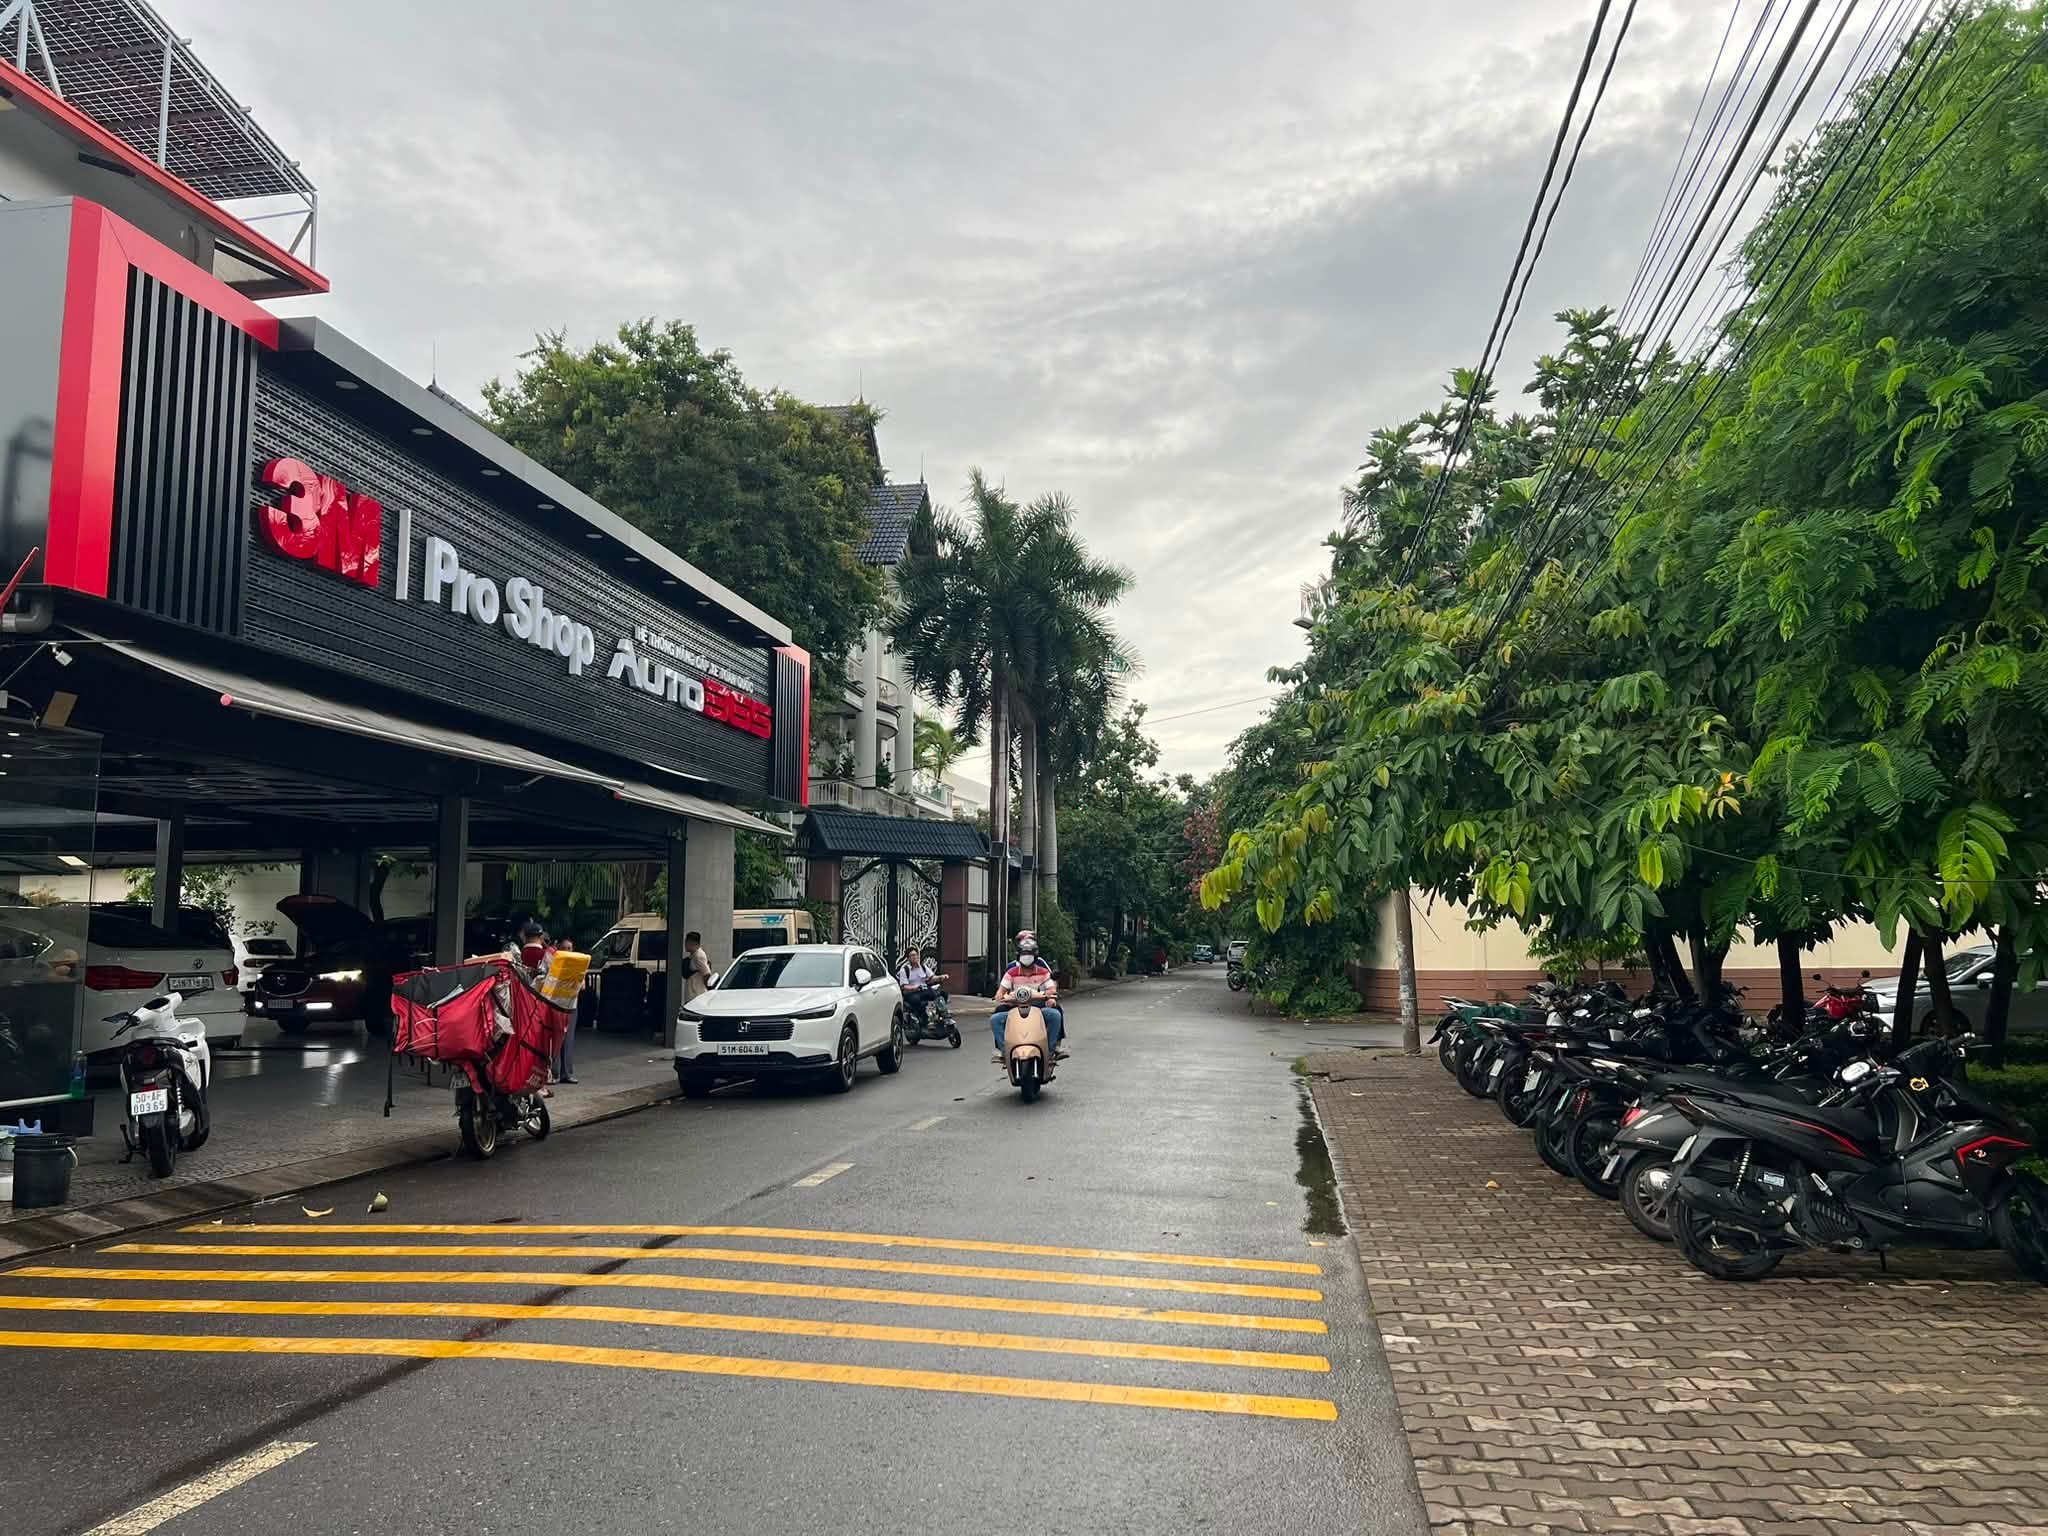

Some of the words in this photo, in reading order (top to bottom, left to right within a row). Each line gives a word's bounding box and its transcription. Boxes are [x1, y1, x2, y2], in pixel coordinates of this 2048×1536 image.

[258, 457, 382, 588] 3M
[423, 536, 500, 625] Pro
[503, 577, 595, 676] Shop
